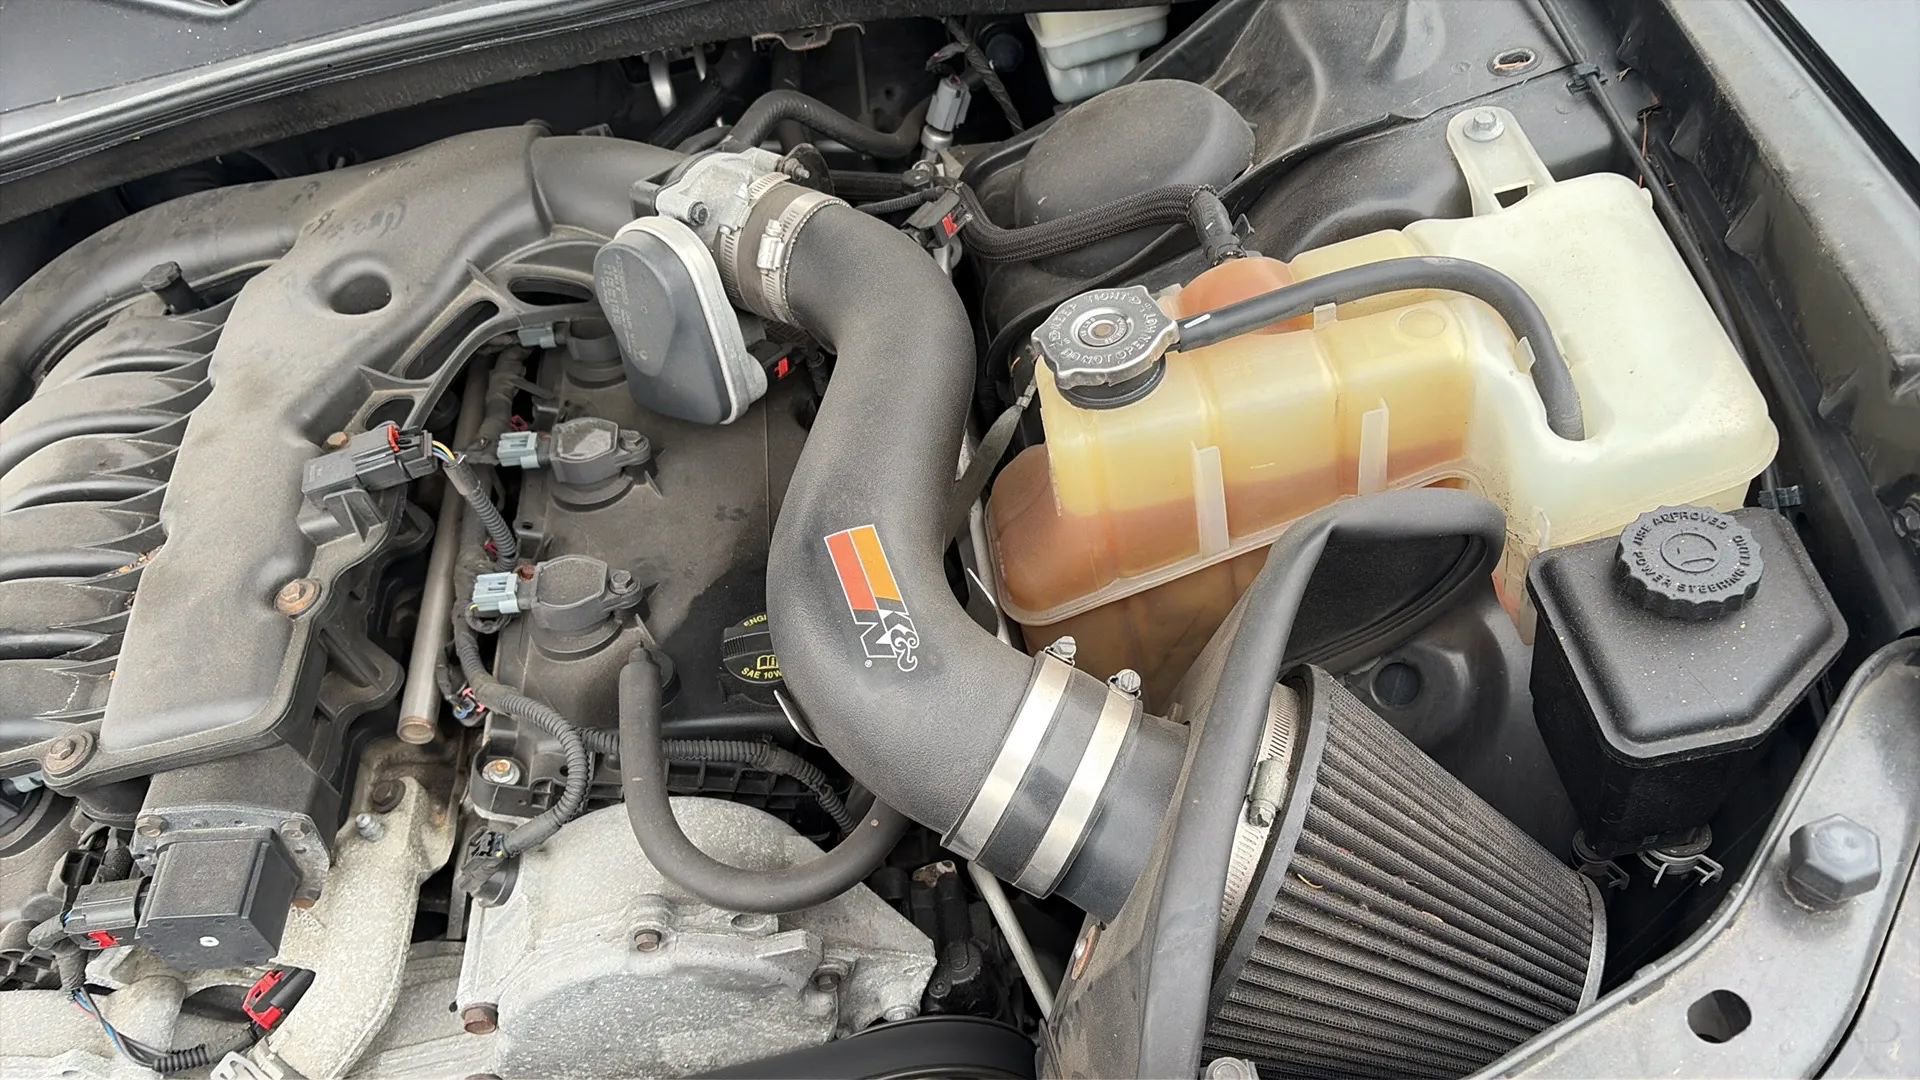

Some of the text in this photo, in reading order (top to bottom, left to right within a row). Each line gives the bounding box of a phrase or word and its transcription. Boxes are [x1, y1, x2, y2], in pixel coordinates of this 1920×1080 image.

[1652, 511, 1728, 531] APPROVED
[1632, 551, 1672, 588] POWER
[1677, 569, 1745, 594] STEERING
[741, 667, 761, 679] SAE
